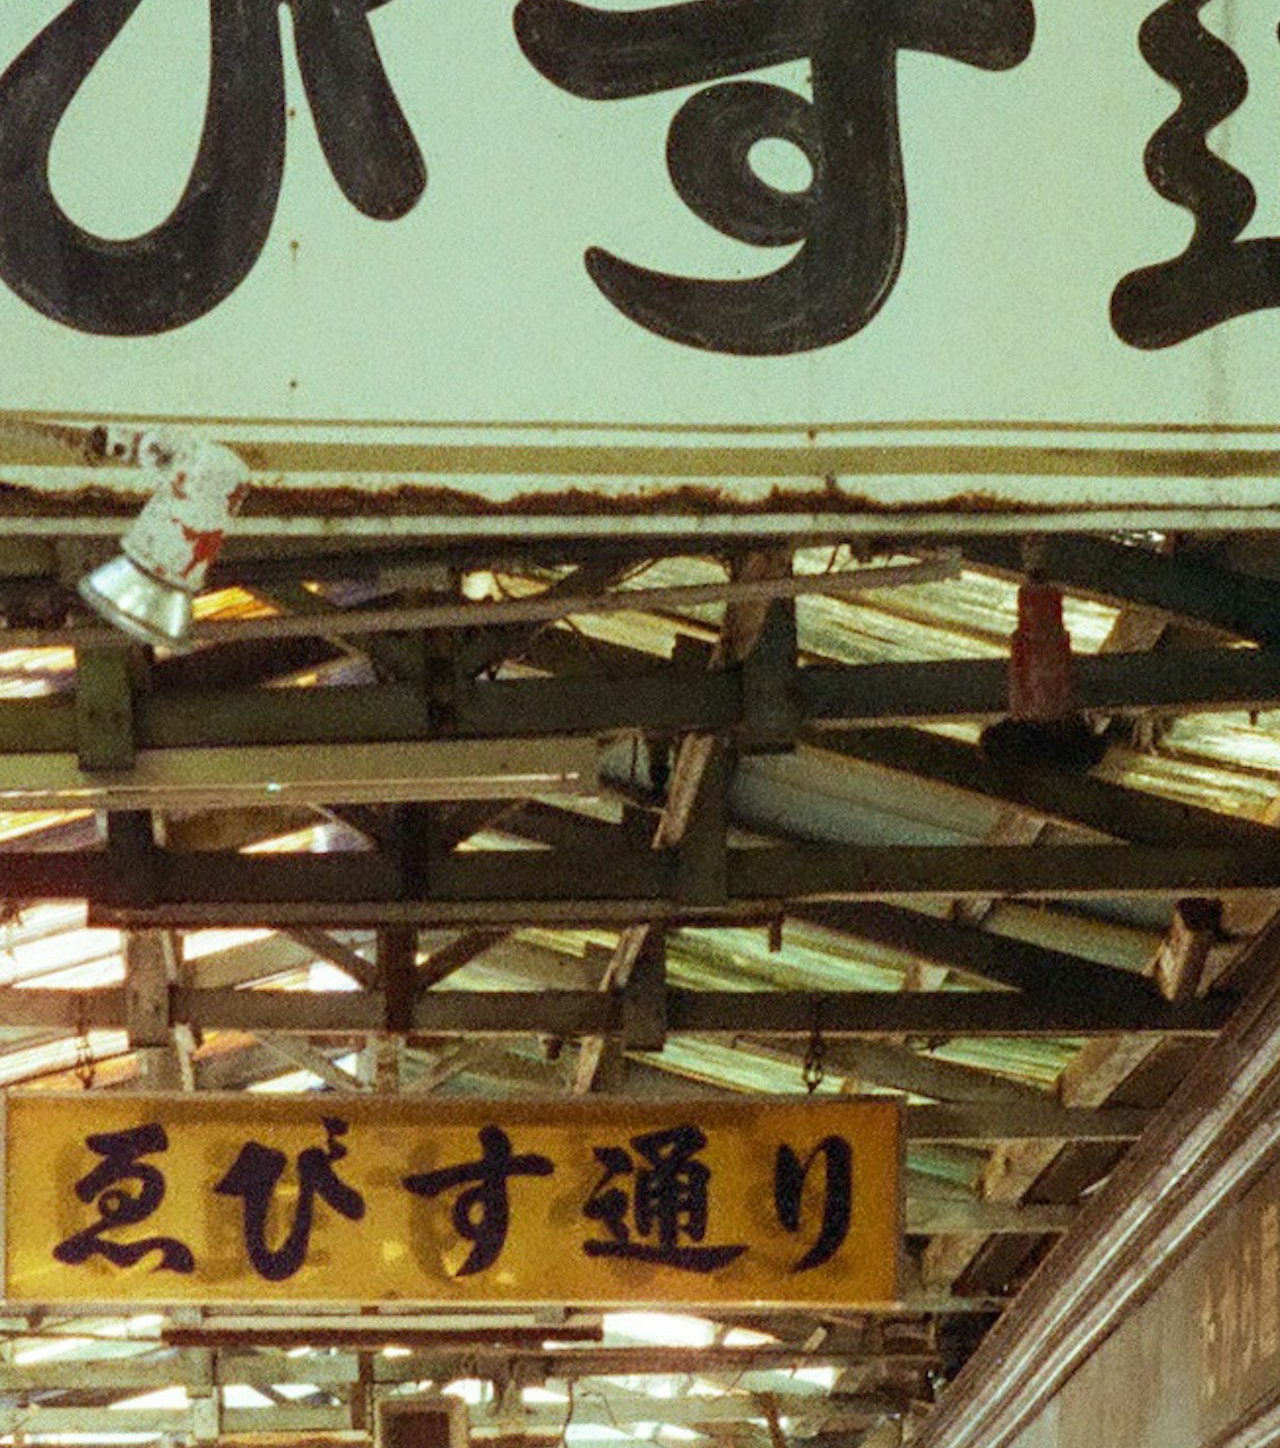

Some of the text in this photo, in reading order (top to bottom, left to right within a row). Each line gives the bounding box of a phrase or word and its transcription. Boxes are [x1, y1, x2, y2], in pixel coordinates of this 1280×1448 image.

[53, 1119, 853, 1283] ゑびす通り
